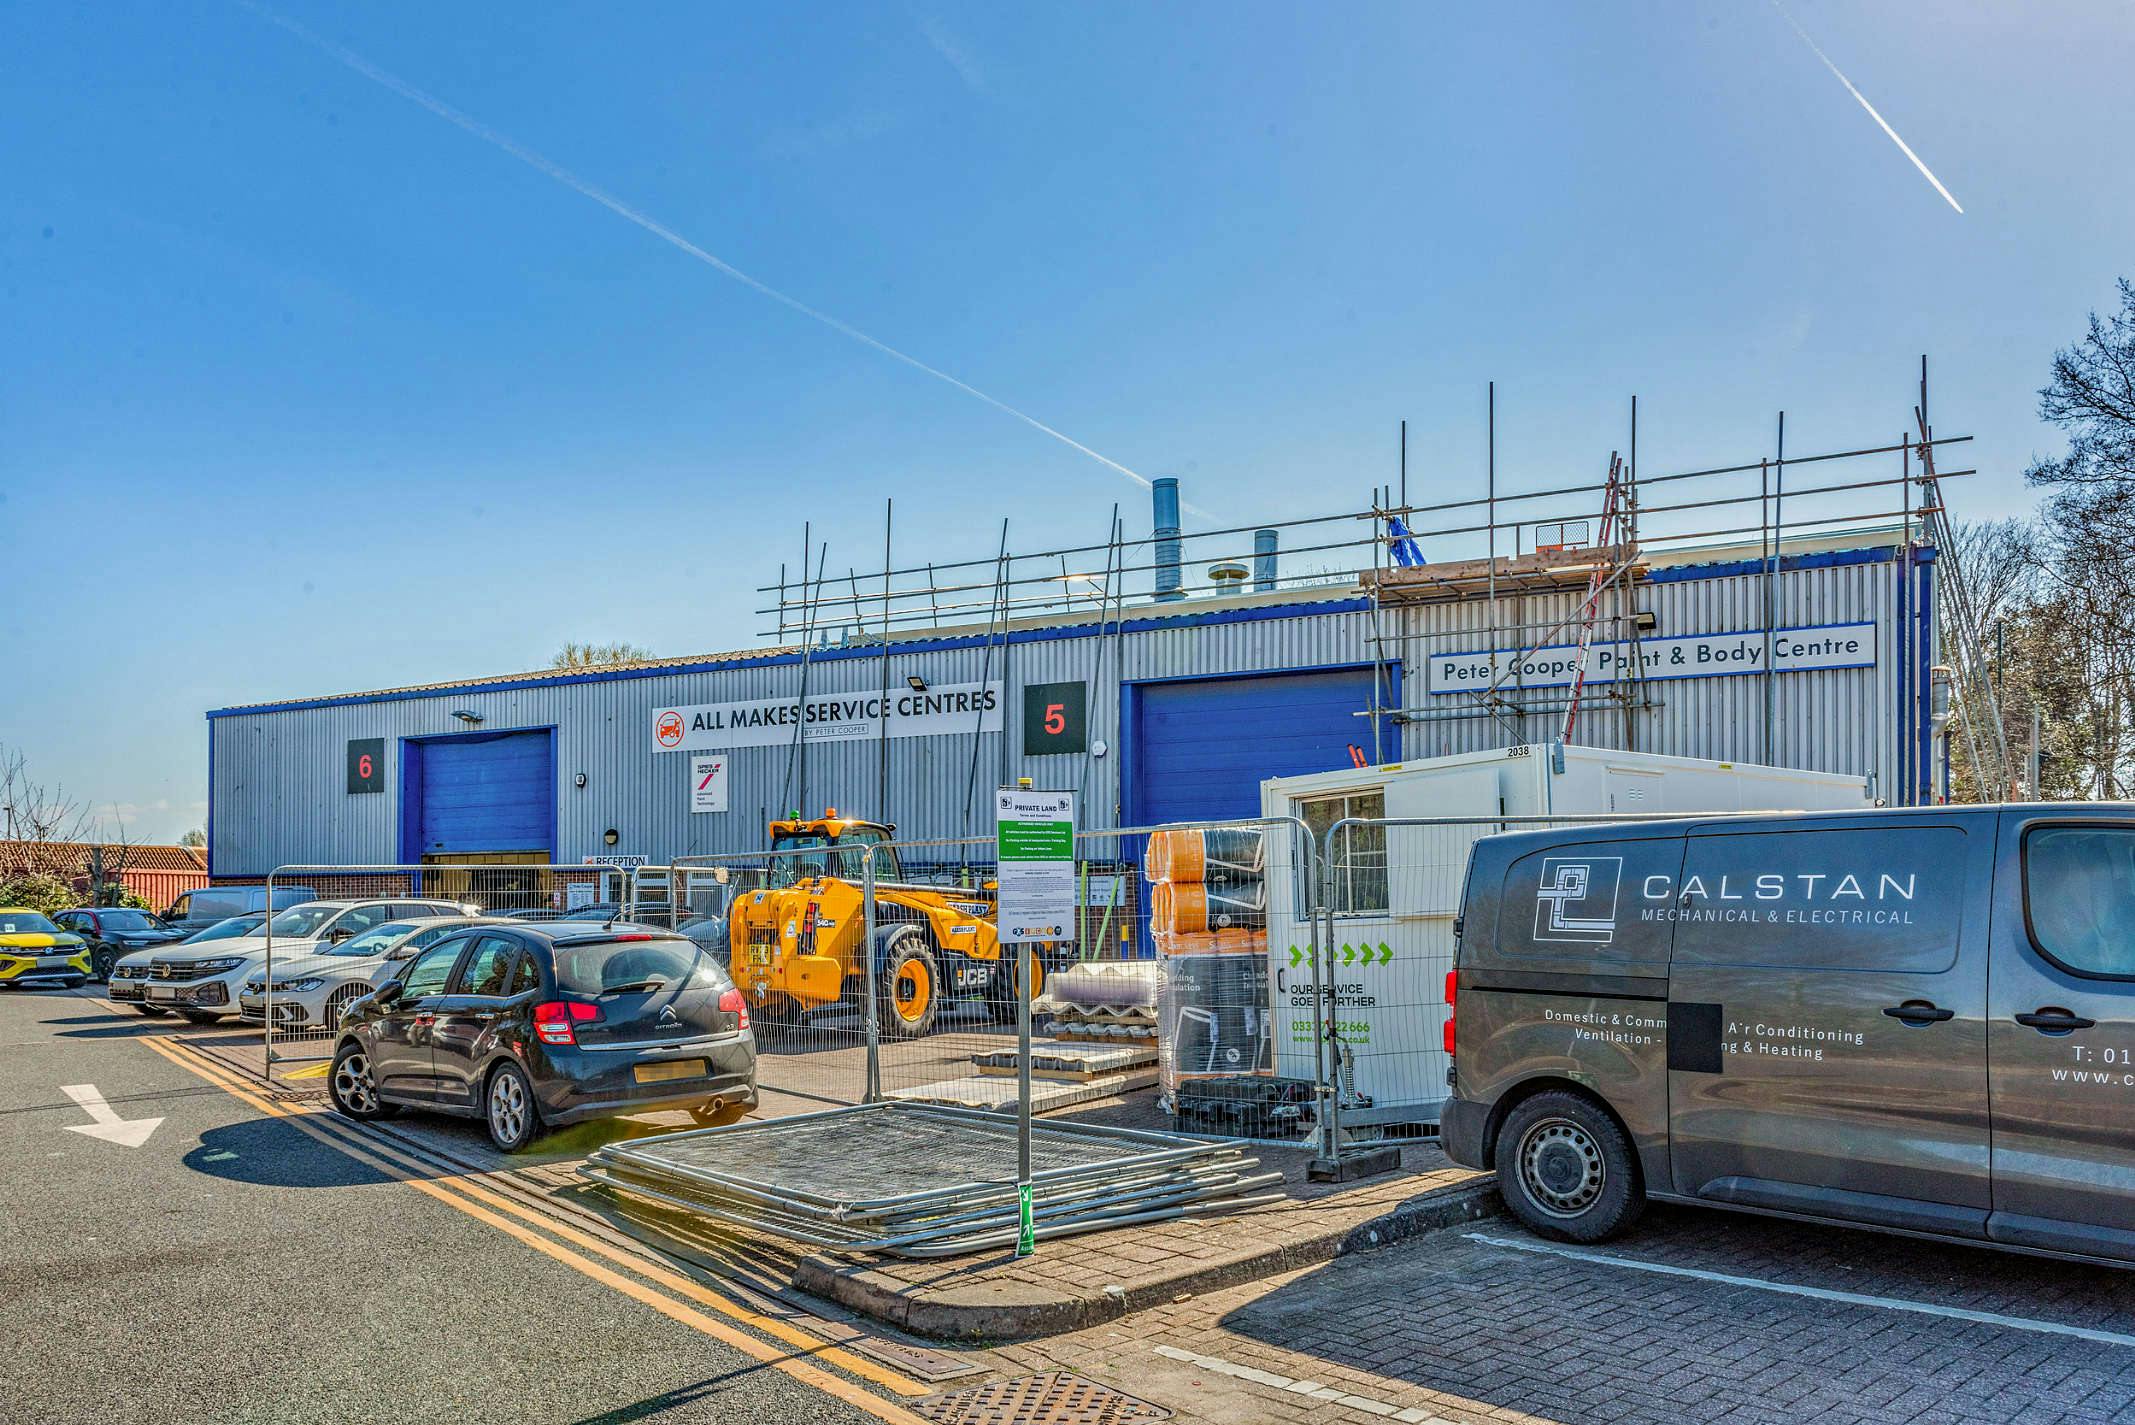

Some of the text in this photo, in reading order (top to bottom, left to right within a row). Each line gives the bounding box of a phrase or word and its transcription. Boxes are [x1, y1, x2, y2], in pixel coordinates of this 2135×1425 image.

[1508, 657, 1588, 678] Coope
[1599, 650, 1661, 670] Paint
[1670, 646, 1686, 665] &
[1697, 640, 1763, 665] Body
[1774, 638, 1860, 658] Centre
[692, 690, 996, 732] ALL MAKES SERVICE CENTRES
[1044, 703, 1065, 735] 5
[804, 726, 867, 737] BY PETER COOPER
[1507, 746, 1529, 757] 2038
[359, 754, 372, 779] 6
[1014, 804, 1040, 812] PRIVATE
[597, 856, 646, 866] RECEPTION
[1643, 873, 1917, 900] CALSTAN
[1641, 907, 1914, 925] MECHANICAL & ELECTRICAL
[957, 968, 988, 987] JCB
[1290, 984, 1314, 994] OUR
[1290, 996, 1376, 1007] GOE FRTHER
[1545, 1009, 1607, 1025] Domestic
[1611, 1014, 1621, 1025] &
[1755, 1023, 1864, 1045] Conditioning
[1575, 1028, 1651, 1044] Ventilation
[1743, 1041, 1753, 1053] &
[1759, 1042, 1824, 1061] Heating
[2072, 1045, 2092, 1062] T:
